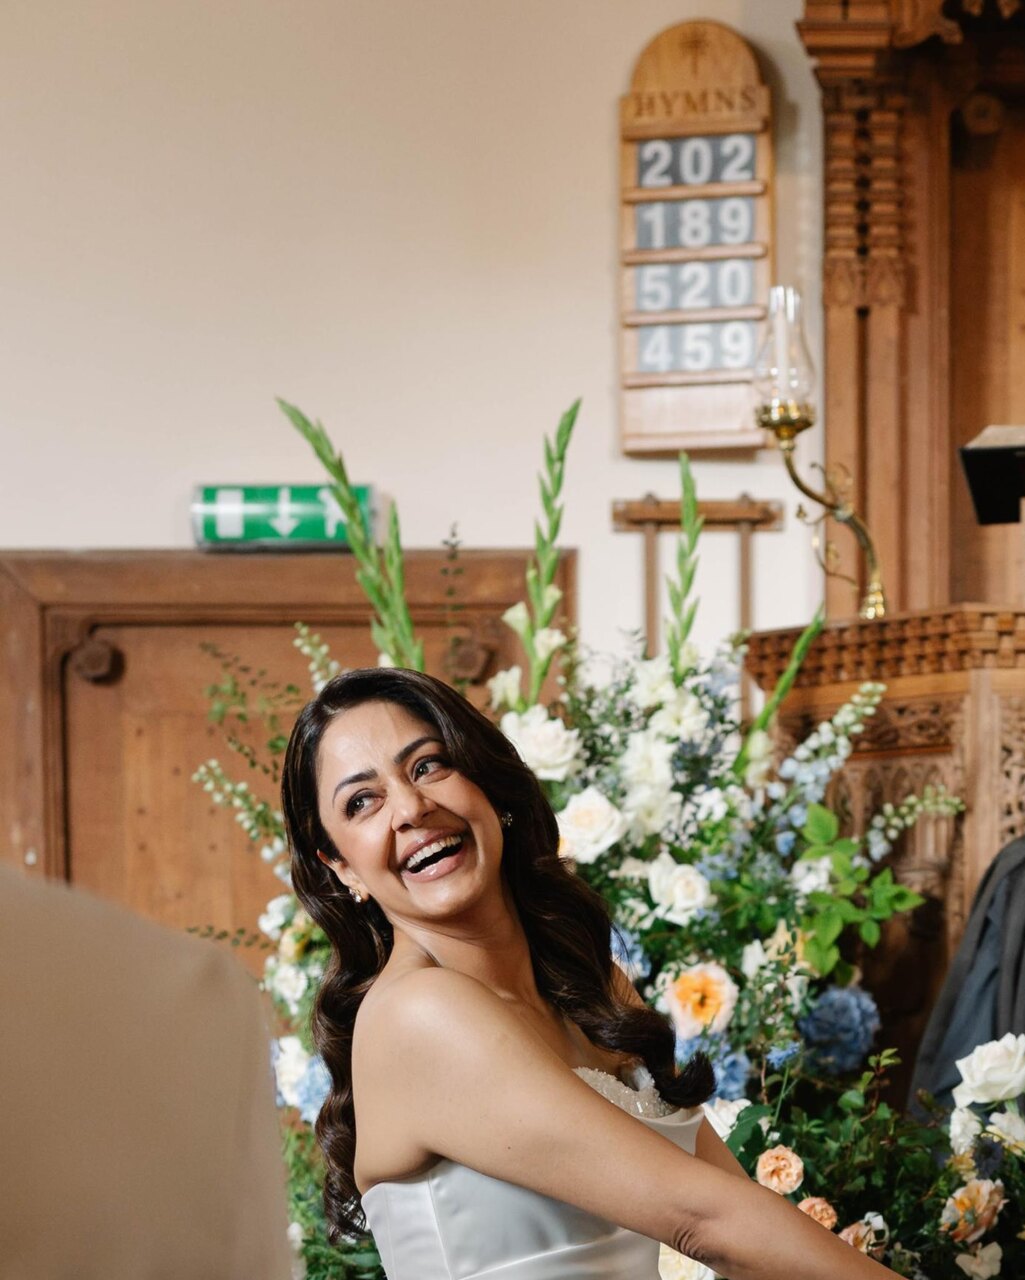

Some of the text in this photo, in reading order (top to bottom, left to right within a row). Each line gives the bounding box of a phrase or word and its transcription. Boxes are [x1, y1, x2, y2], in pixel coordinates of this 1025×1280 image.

[635, 86, 756, 117] HYMNS
[643, 137, 753, 187] 202
[644, 201, 751, 249] 189
[642, 263, 752, 312] 520
[643, 323, 752, 371] 459
